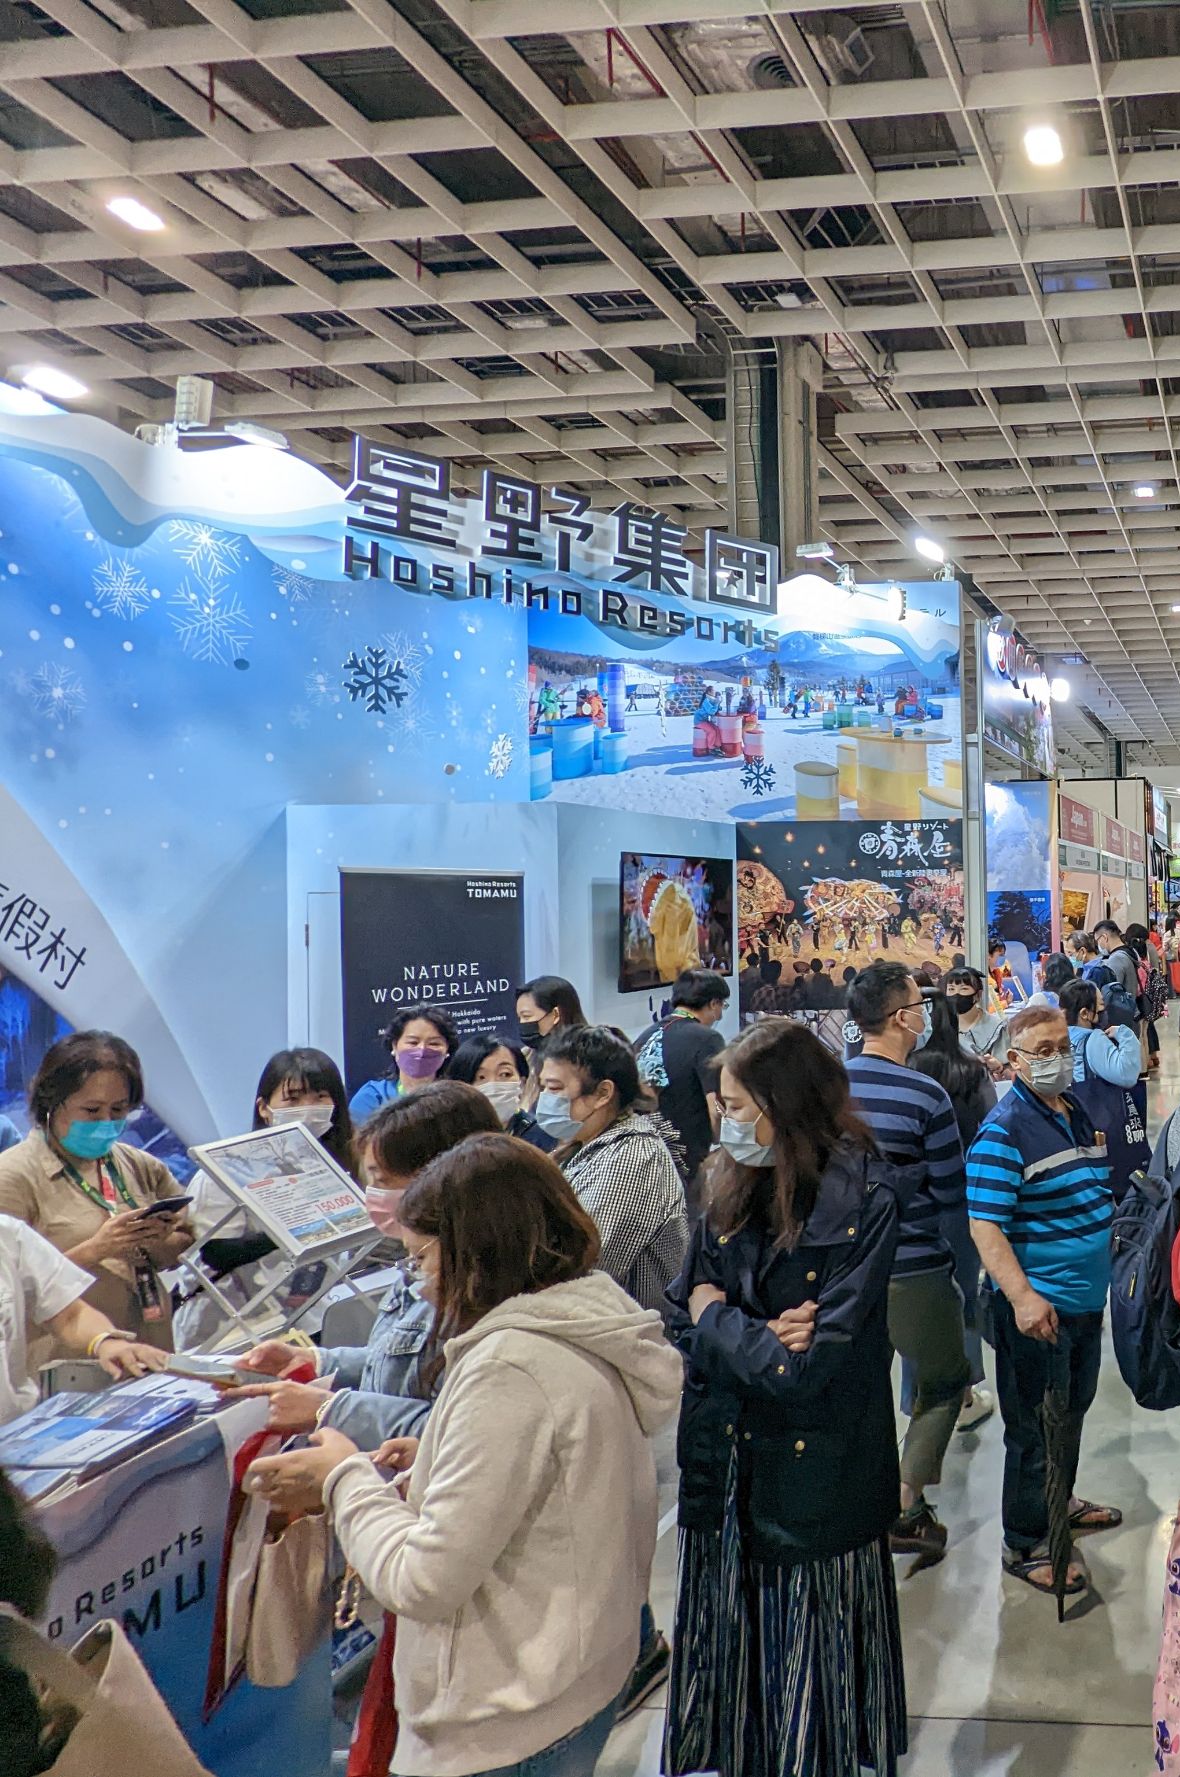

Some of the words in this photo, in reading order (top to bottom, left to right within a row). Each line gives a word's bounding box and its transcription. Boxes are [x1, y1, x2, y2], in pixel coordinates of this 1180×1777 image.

[342, 536, 582, 616] Hoshino
[599, 589, 780, 653] Resorts
[904, 820, 949, 831] 星野リゾート
[466, 888, 518, 898] TOMAMU
[403, 962, 480, 980] NATURE
[371, 978, 510, 1004] WONDERLAND
[75, 1525, 203, 1625] Resorts
